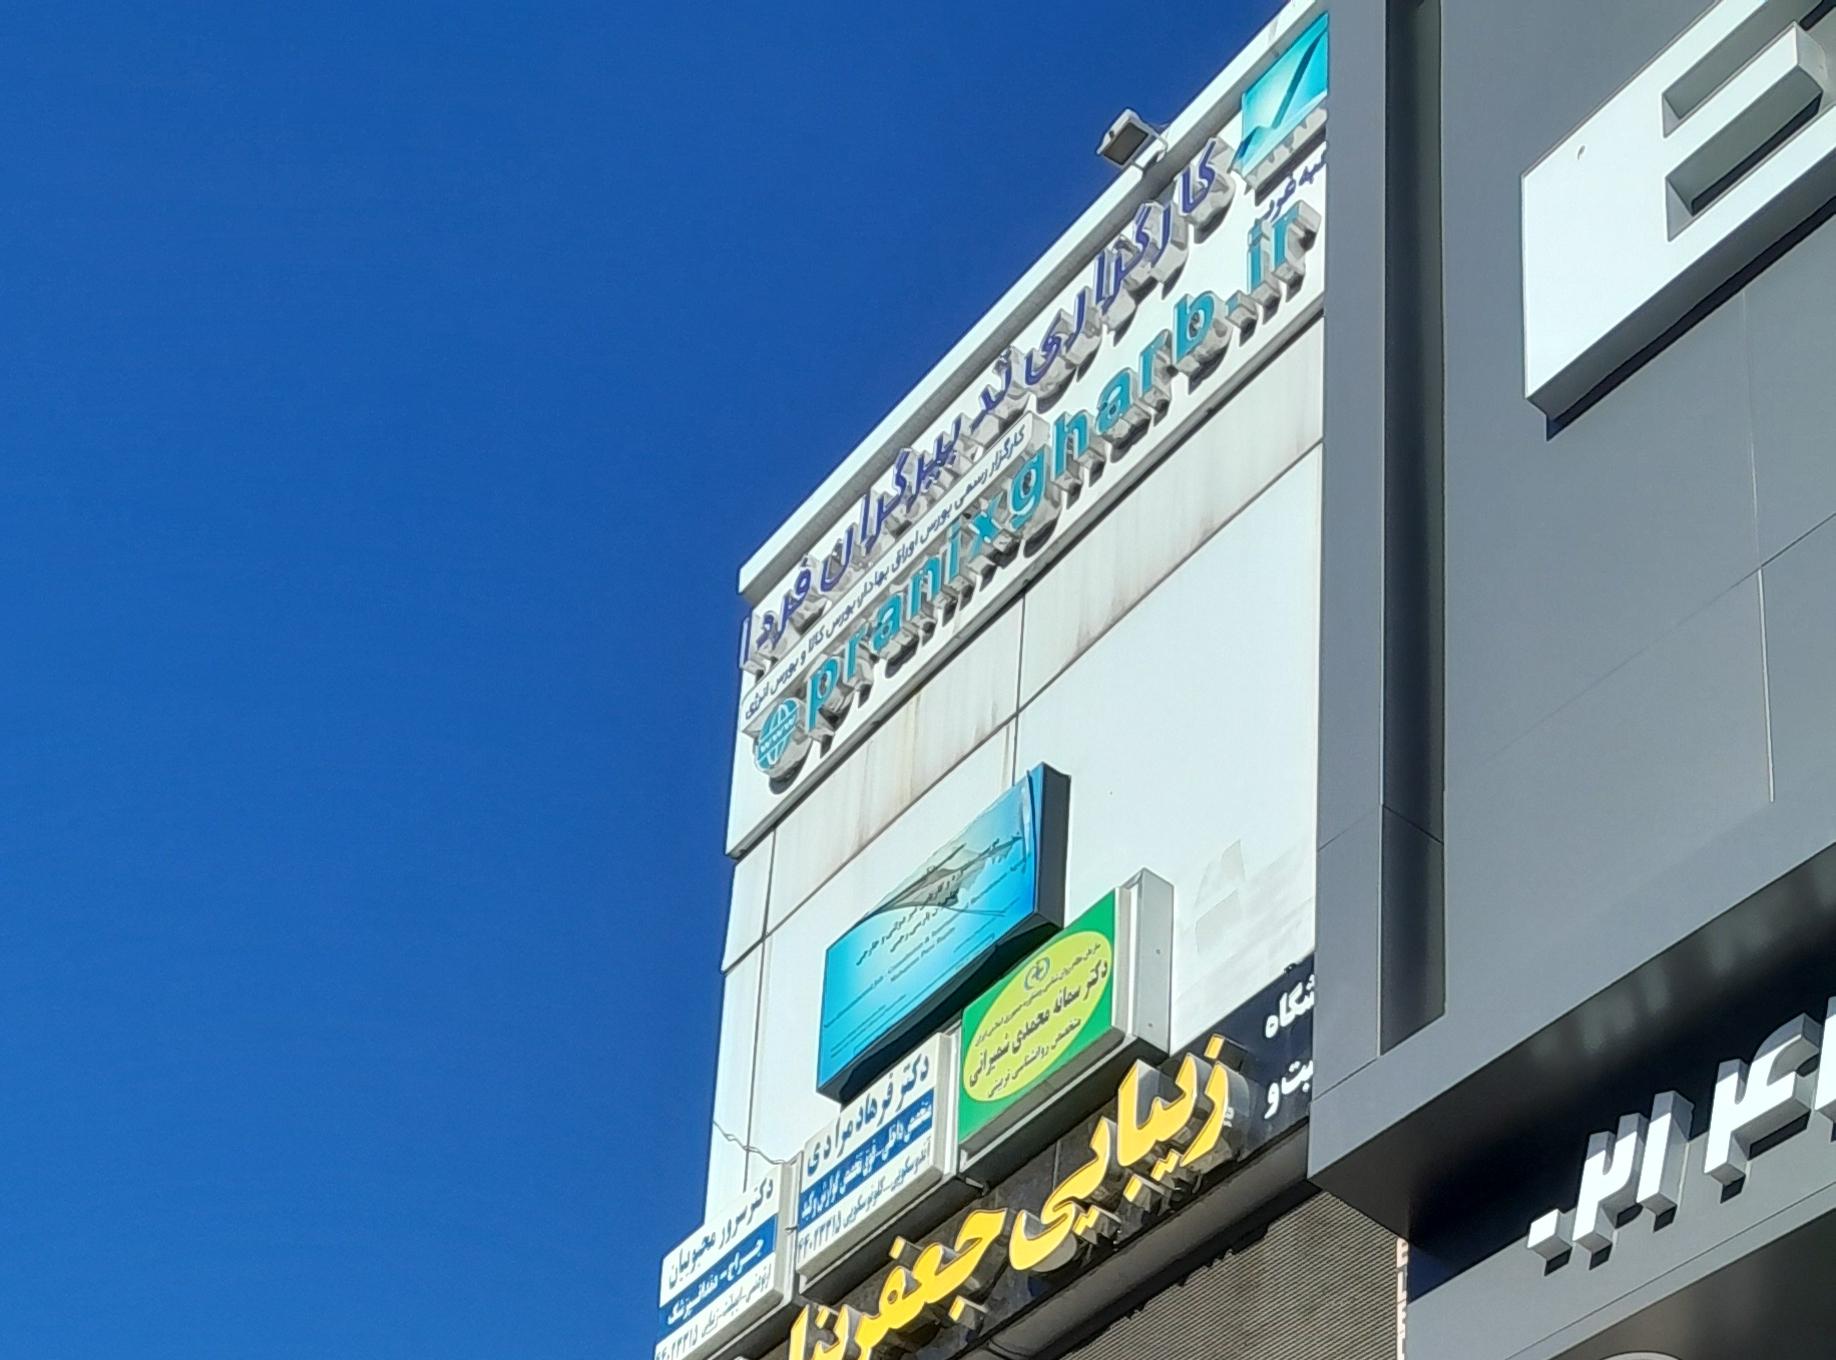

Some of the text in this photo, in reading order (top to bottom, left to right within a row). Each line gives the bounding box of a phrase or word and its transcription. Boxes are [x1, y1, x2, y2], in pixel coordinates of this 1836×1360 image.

[739, 139, 1216, 670] کارگزاری تدبیرگران فردا
[1083, 959, 1108, 1001] دکتر
[896, 1053, 930, 1112] دکتر
[1009, 1033, 1230, 1272] زیبایی
[747, 1176, 774, 1226] دکتر
